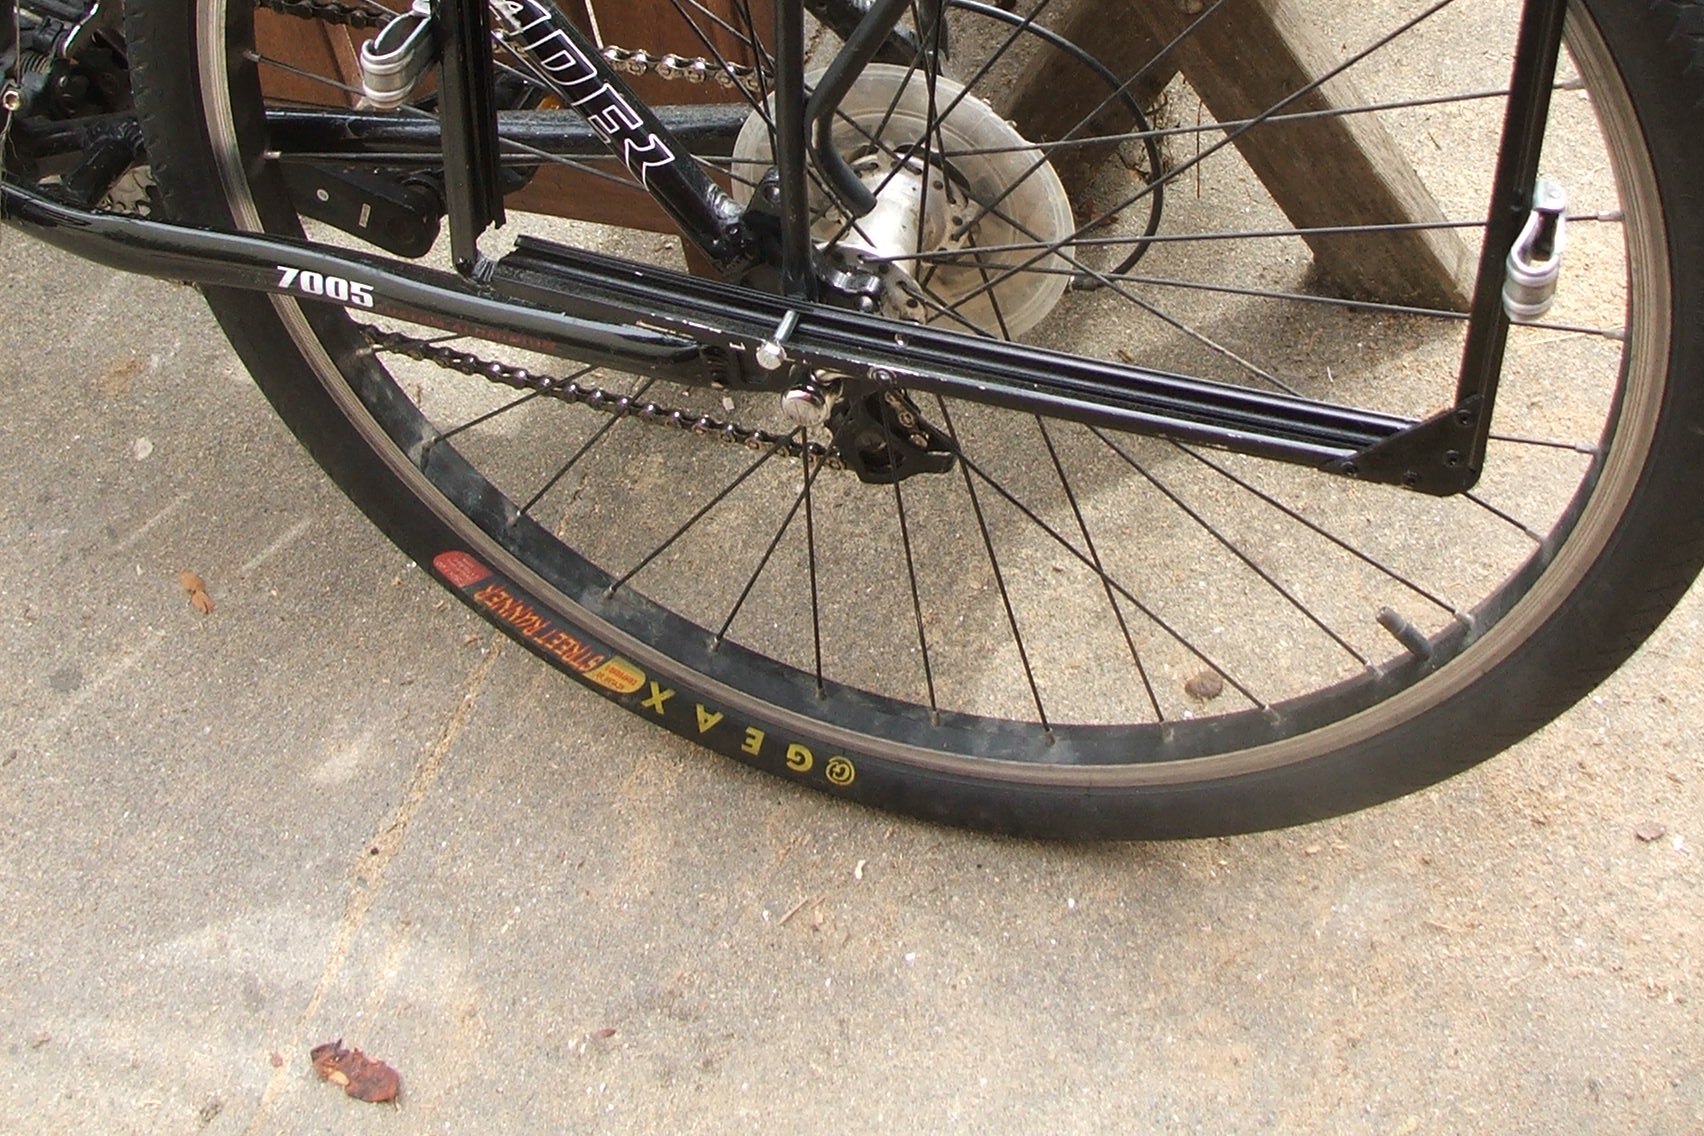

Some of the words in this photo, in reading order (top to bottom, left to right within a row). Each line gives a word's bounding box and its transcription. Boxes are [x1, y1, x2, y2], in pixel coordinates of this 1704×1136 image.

[276, 265, 375, 308] 7005
[473, 581, 551, 637] RUNNER
[533, 626, 605, 673] STREET
